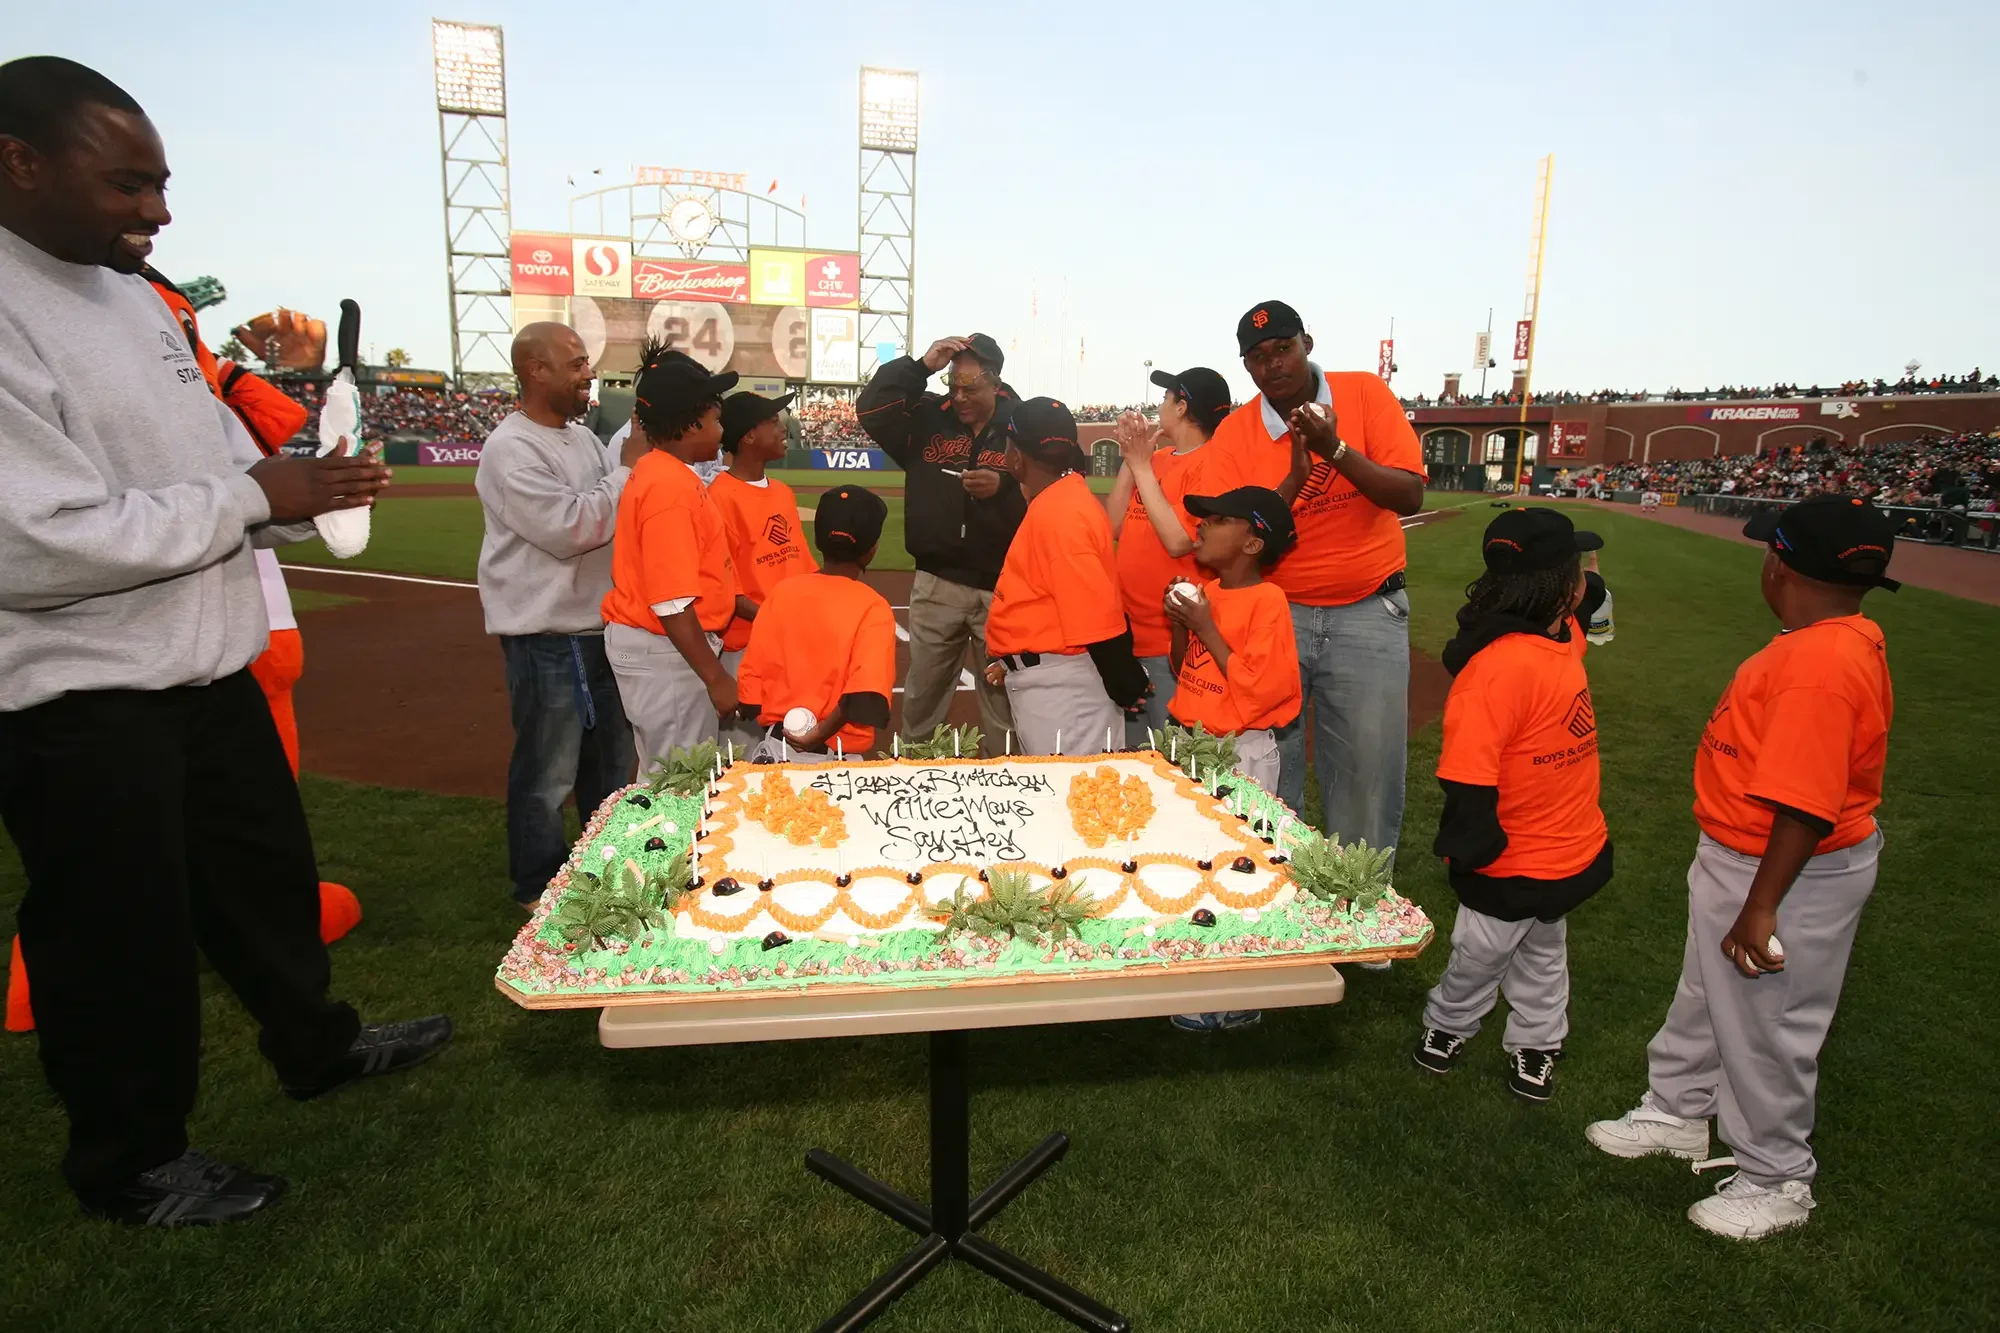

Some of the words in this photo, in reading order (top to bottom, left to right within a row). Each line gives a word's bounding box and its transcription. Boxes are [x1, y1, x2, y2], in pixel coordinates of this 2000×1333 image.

[693, 169, 748, 192] PARK
[517, 263, 570, 277] TOYOTA
[584, 279, 620, 288] SAFEWAY
[634, 271, 746, 293] Budweiser
[818, 280, 844, 291] CHW
[664, 316, 722, 356] 24
[177, 367, 203, 384] STAF
[1711, 407, 1780, 420] KRAGEN
[823, 450, 871, 469] VISA
[1496, 482, 1514, 492] 309
[1532, 750, 1565, 766] BOYS
[1567, 747, 1576, 757] &
[810, 770, 918, 800] Happy
[917, 768, 1055, 796] Birthday
[956, 795, 1034, 828] Mays
[880, 826, 956, 862] Say
[952, 822, 1026, 861] Hey
